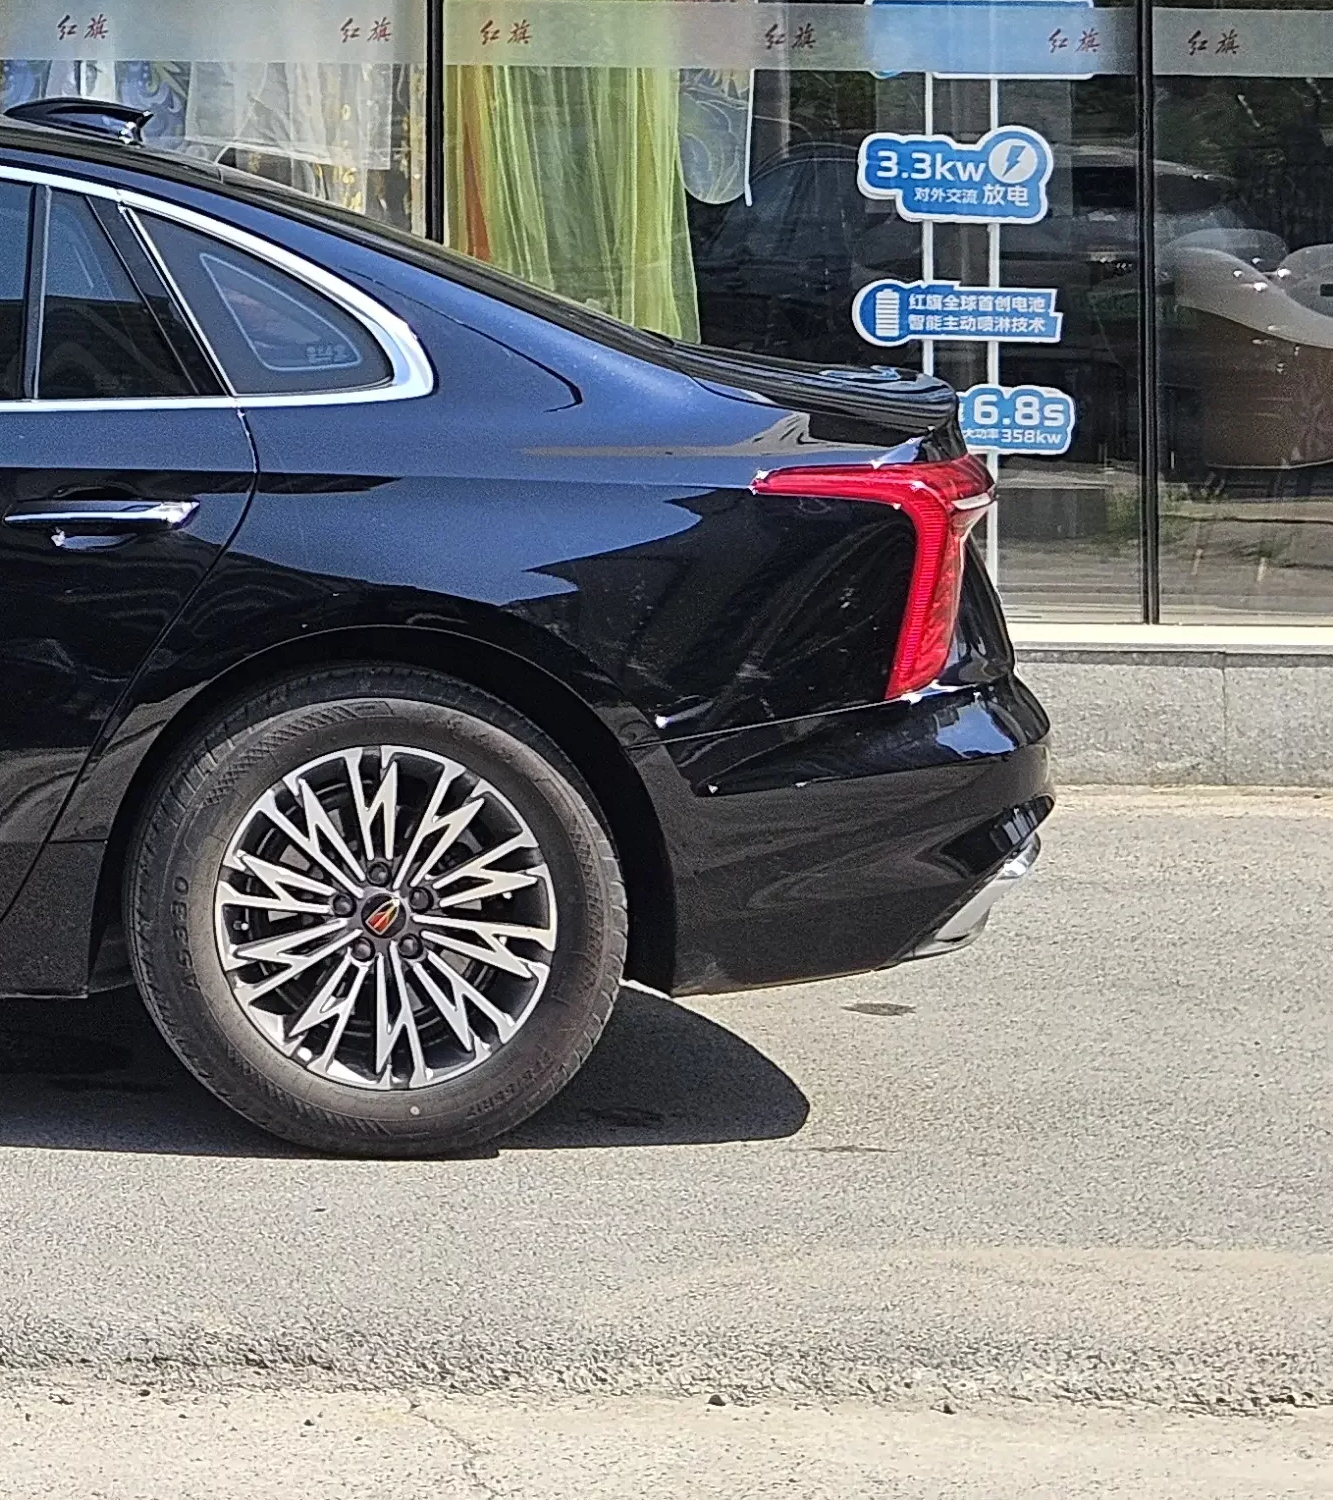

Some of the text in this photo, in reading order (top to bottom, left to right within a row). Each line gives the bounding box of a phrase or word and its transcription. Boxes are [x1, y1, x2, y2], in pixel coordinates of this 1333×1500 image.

[56, 13, 109, 40] 红旗
[340, 16, 393, 43] 红旗
[480, 19, 533, 45] 红旗
[765, 22, 817, 49] 红旗
[1048, 27, 1101, 53] 红旗
[1187, 29, 1239, 56] 红旗
[876, 150, 986, 182] 3.3kw
[982, 183, 1029, 207] 放电
[1001, 429, 1061, 444] 358kw
